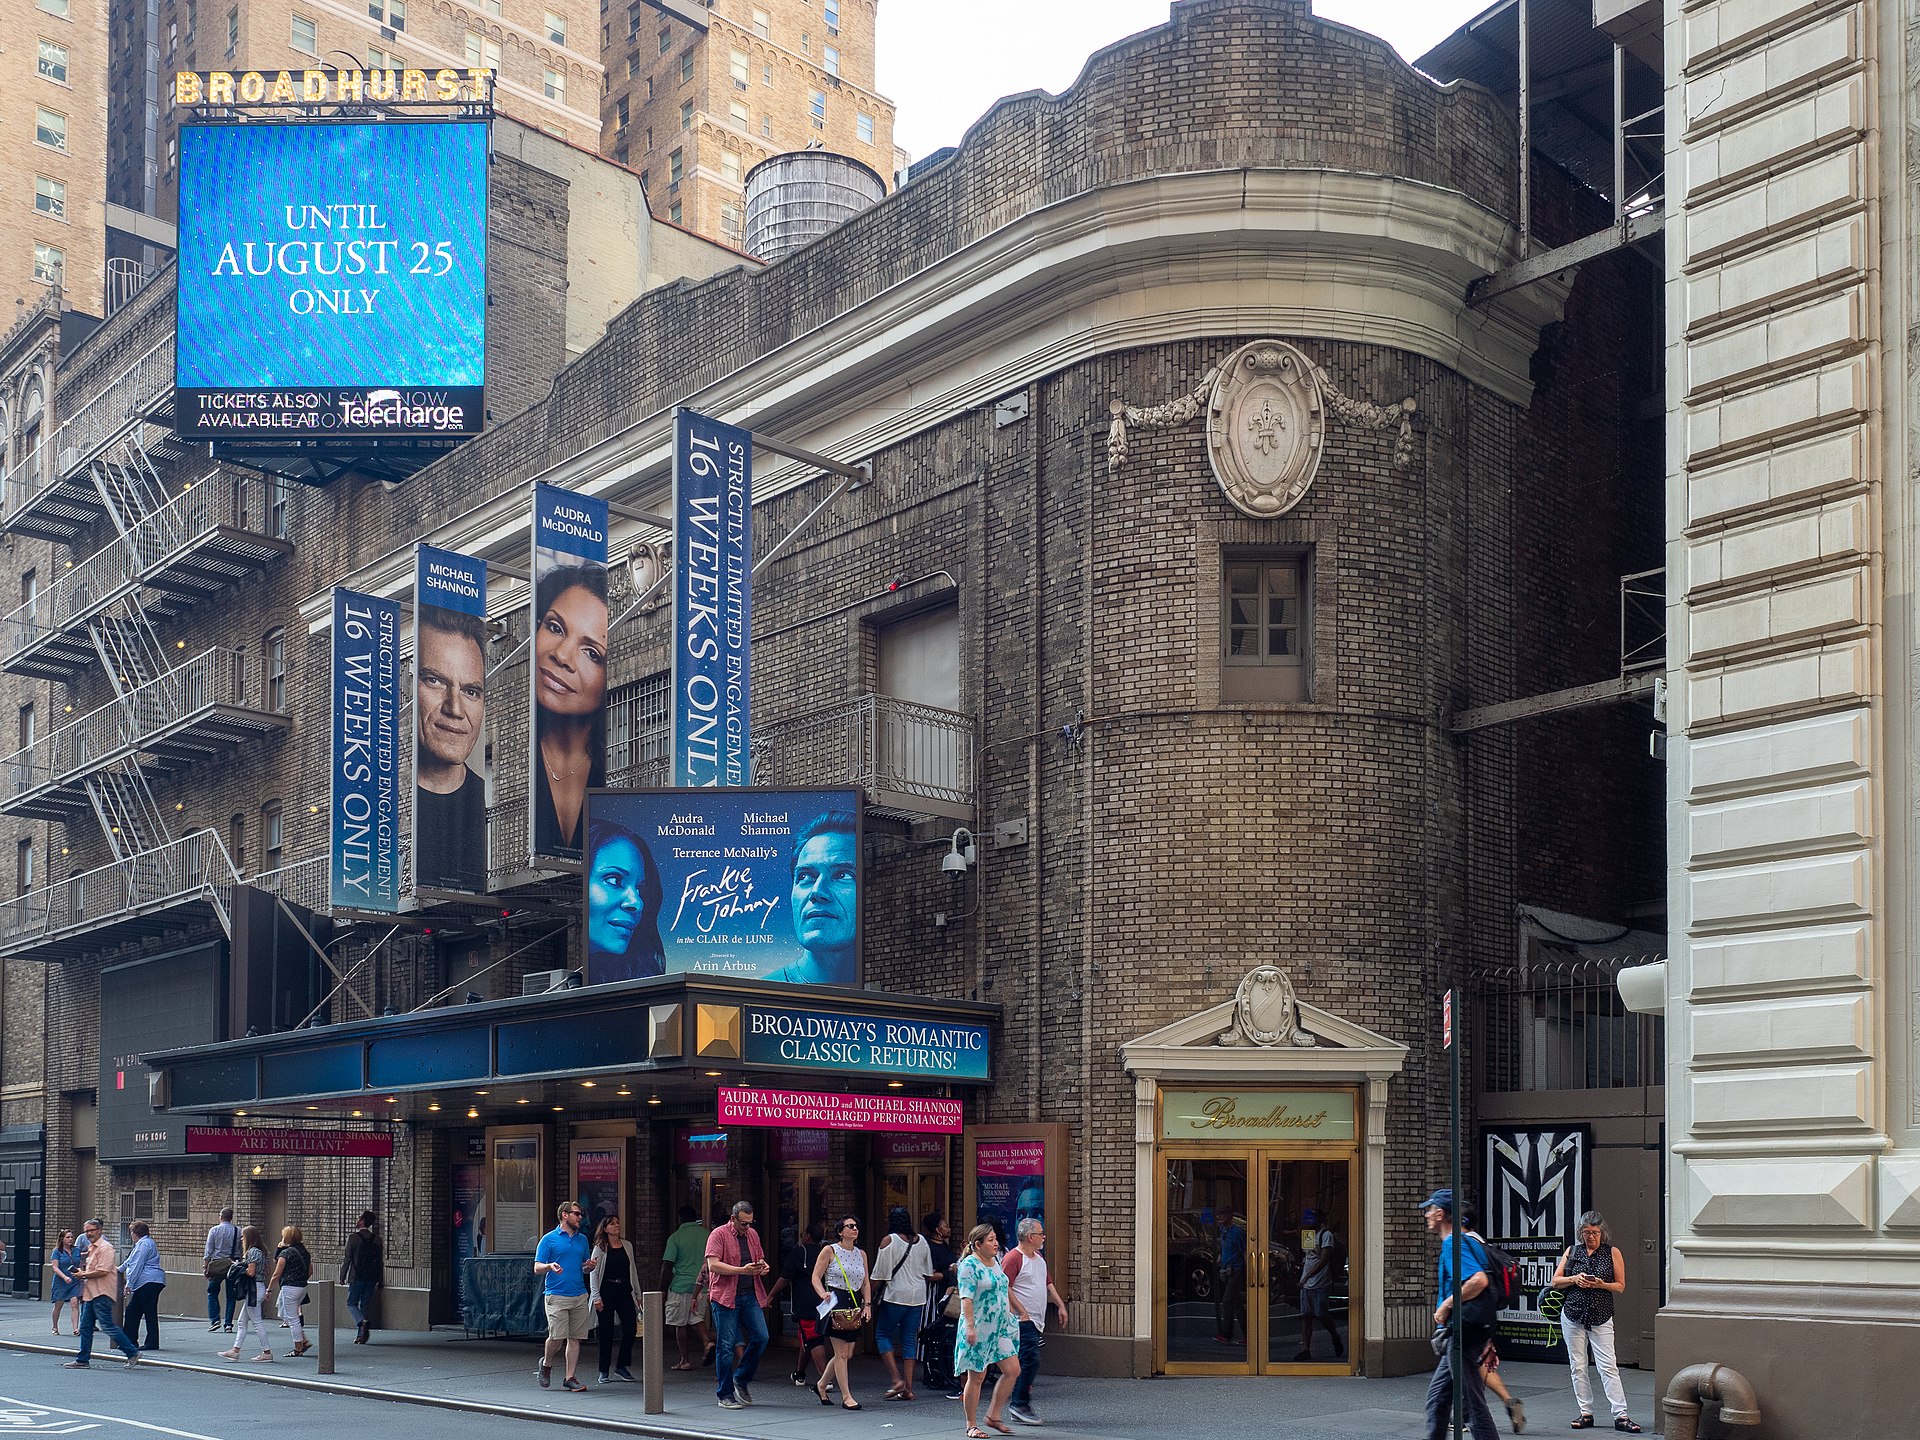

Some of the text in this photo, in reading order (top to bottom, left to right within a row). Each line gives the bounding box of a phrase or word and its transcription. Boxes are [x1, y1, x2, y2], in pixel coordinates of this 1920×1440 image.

[176, 69, 491, 103] BROADHURST
[286, 204, 386, 230] UNTIL
[212, 240, 453, 277] AUGUST 25
[289, 288, 380, 315] ONLY
[197, 394, 267, 409] TICKETS
[272, 394, 319, 409] ALSO
[197, 413, 293, 427] AVAILABLE
[297, 413, 320, 427] AT
[339, 397, 464, 430] Telecharge
[689, 429, 721, 478] 16
[553, 505, 592, 525] AUDRA
[542, 515, 603, 542] McDONALD
[430, 563, 476, 584] MICHAEL
[687, 494, 720, 663] WEEKS
[426, 576, 479, 598] SHANNON
[726, 441, 744, 787] STRICTLY LIMITED ENGAGEME
[343, 602, 373, 898] 16 WEEKS ONLY
[377, 610, 394, 900] STRICTLY LIMITED ENGAGEMENT
[669, 813, 703, 824] Audra
[743, 812, 788, 823] Michael
[657, 825, 716, 836] McDonald
[740, 824, 791, 835] Shannon
[672, 846, 778, 860] Terrence McNally's
[670, 865, 752, 931] Frankie
[696, 893, 780, 932] Johnny
[676, 934, 774, 944] in the CLAIR de LUNE
[693, 960, 757, 971] Arin Arbus
[751, 1013, 982, 1051] BROADWAY'S ROMANTIC
[780, 1039, 957, 1070] CLASSIC RETURNS!
[720, 1090, 961, 1114] "AUDRA McDONALD and MICHAEL SHANNON
[1190, 1096, 1328, 1130] Broadhurst
[724, 1104, 961, 1126] GIVE TWO SUPERCHARGED PERFORMANCES!"
[135, 1131, 167, 1141] KING KONG
[189, 1127, 228, 1136] "AUDRA
[231, 1127, 288, 1138] McDONALD
[301, 1130, 344, 1139] MICHAEL
[346, 1132, 391, 1141] SHANNON
[239, 1138, 350, 1151] ARE BRILLIANT."
[892, 1142, 941, 1154] Critic's Pick
[1010, 1148, 1043, 1157] SHANNON
